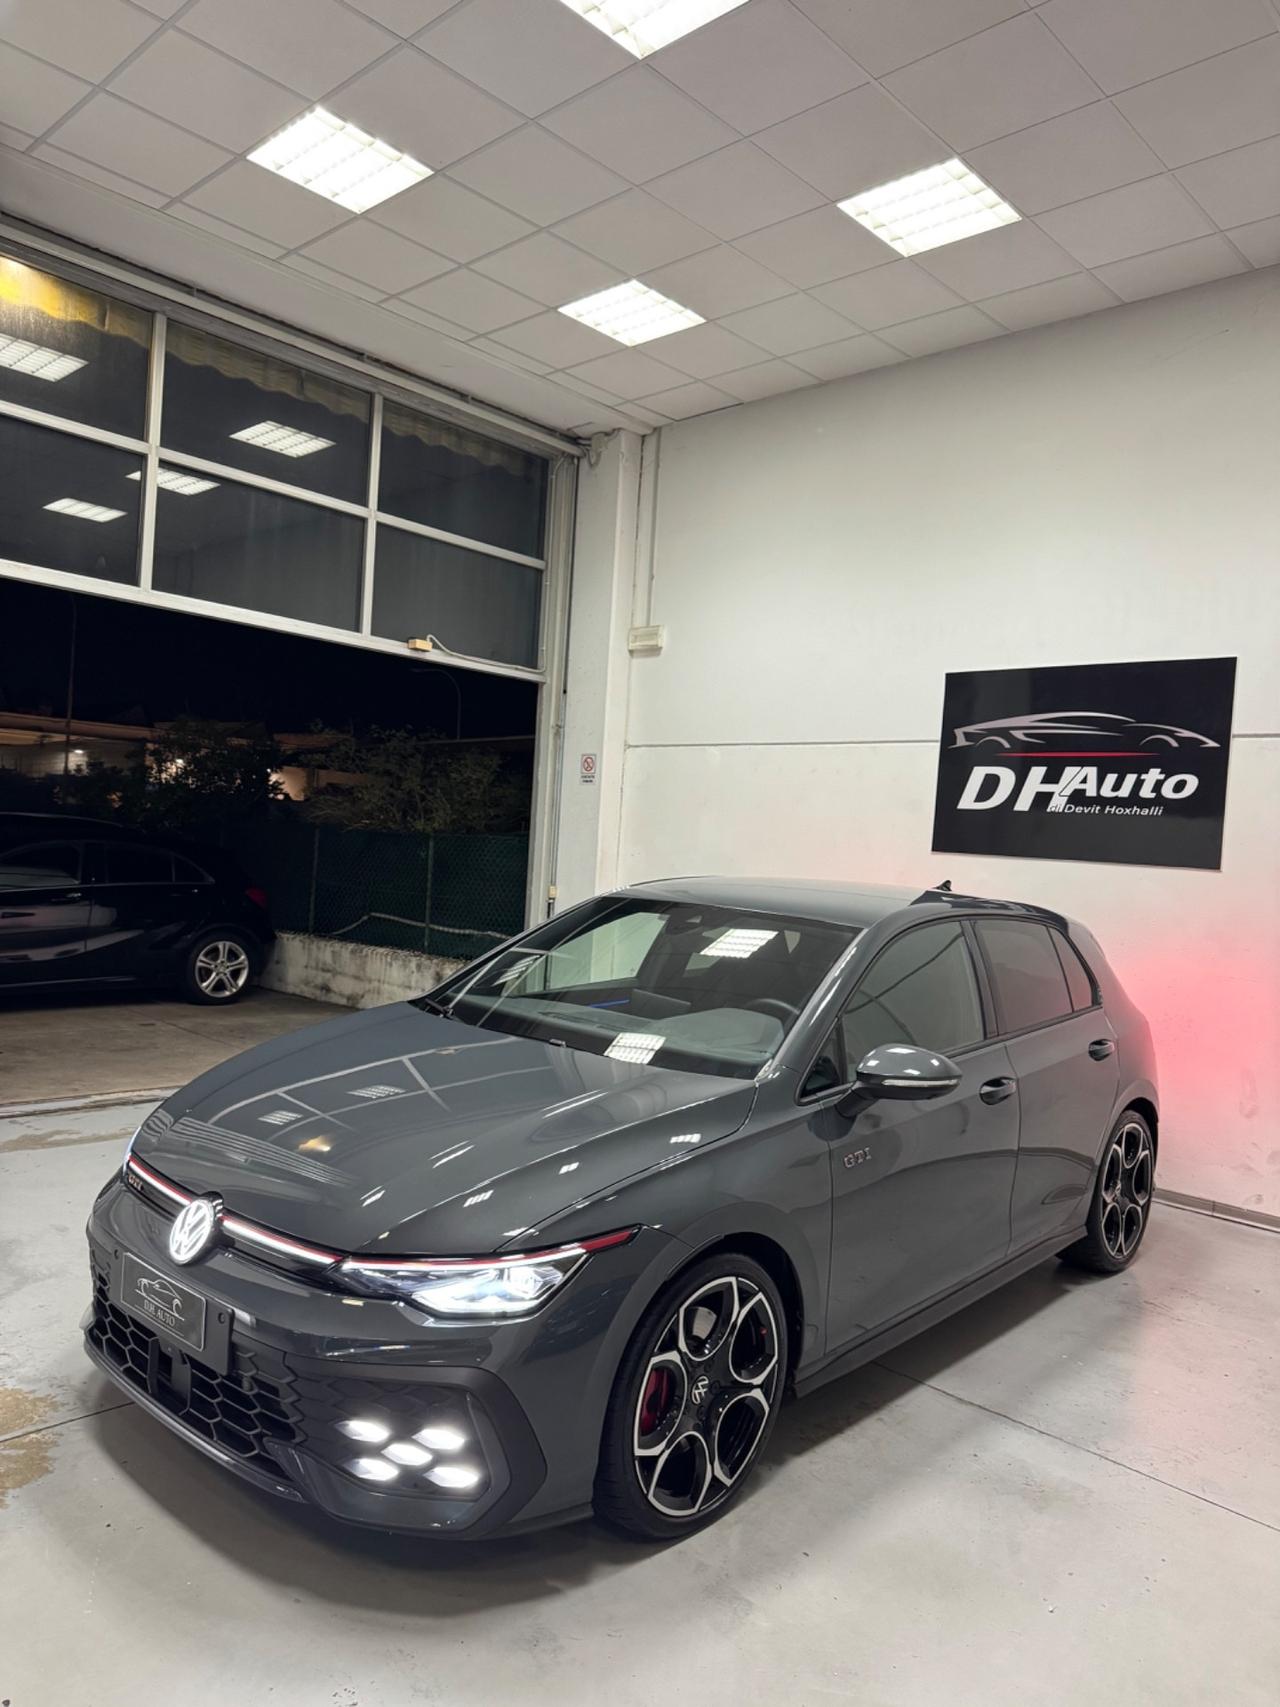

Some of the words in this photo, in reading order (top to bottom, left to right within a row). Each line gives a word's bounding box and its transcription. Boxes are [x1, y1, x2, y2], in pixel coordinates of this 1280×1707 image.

[1064, 804, 1101, 814] Devit
[1104, 805, 1164, 816] Hoxhalli
[844, 1147, 872, 1168] GTI
